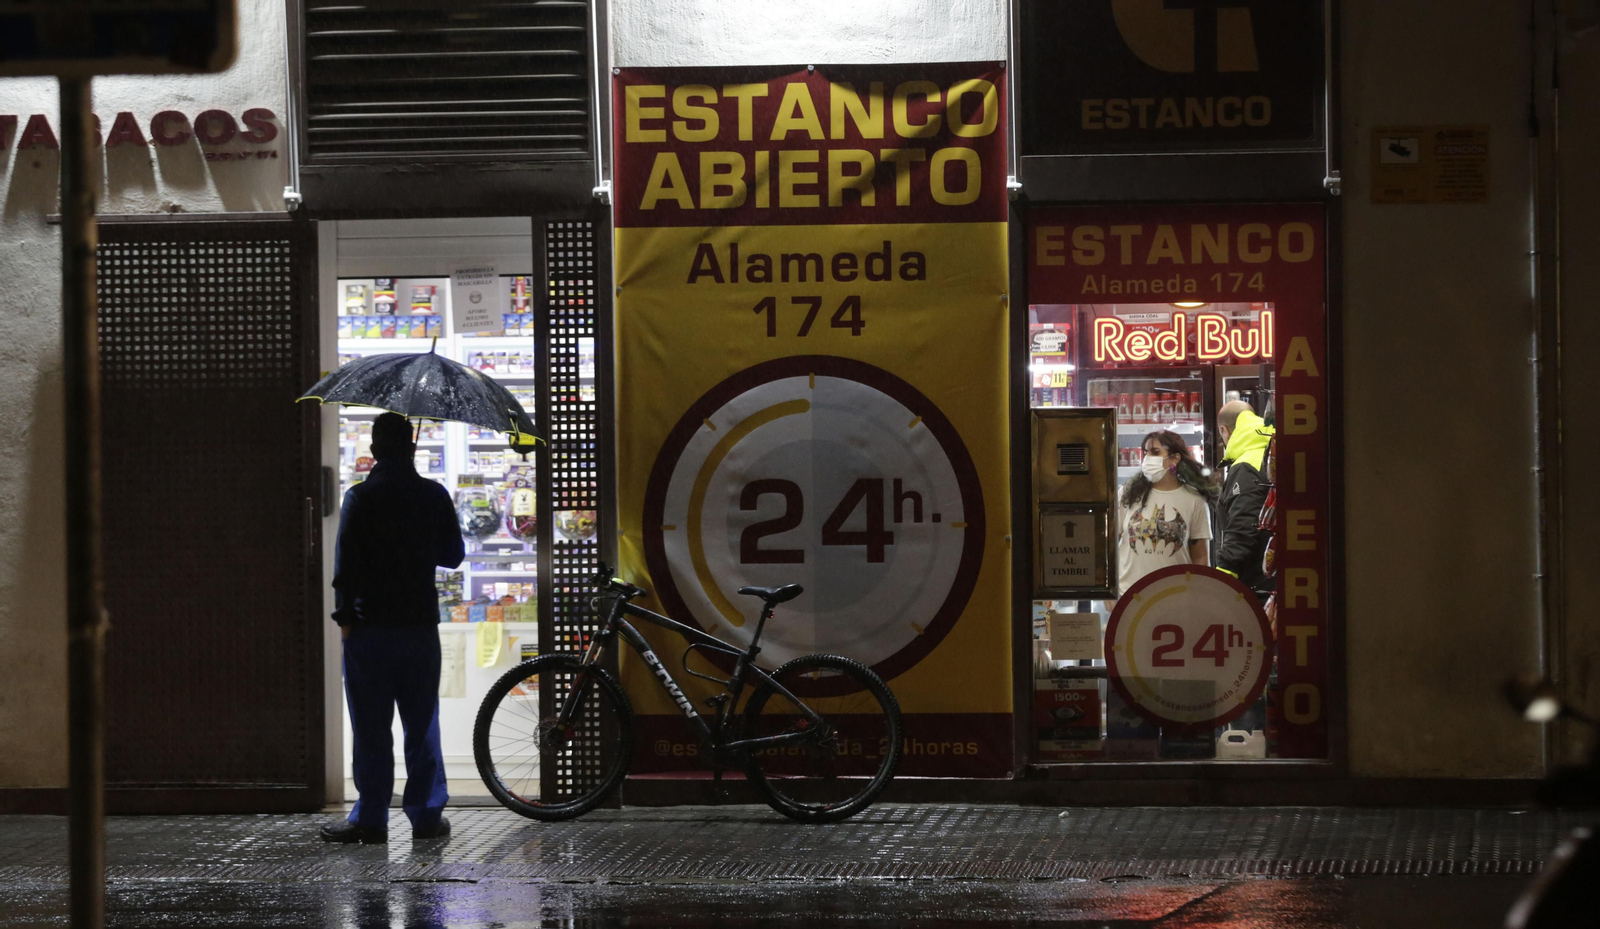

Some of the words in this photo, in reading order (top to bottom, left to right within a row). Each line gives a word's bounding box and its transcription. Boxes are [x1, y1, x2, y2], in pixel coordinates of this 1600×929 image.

[0, 107, 278, 150] TAACOS
[625, 79, 998, 143] ESTANCO
[1081, 95, 1272, 130] ESTANCO
[639, 147, 982, 211] ABIERTO
[686, 241, 927, 284] Alameda
[1036, 222, 1315, 267] ESTANCO
[1081, 274, 1198, 295] Alameda
[1210, 272, 1265, 293] 174
[752, 295, 865, 337] 174
[1094, 313, 1186, 361] Red
[739, 478, 941, 564] 24h.
[1280, 335, 1321, 725] ABIERTO
[1049, 547, 1090, 555] LLAMAR
[1063, 557, 1076, 565] AL
[1151, 624, 1253, 668] 24h.
